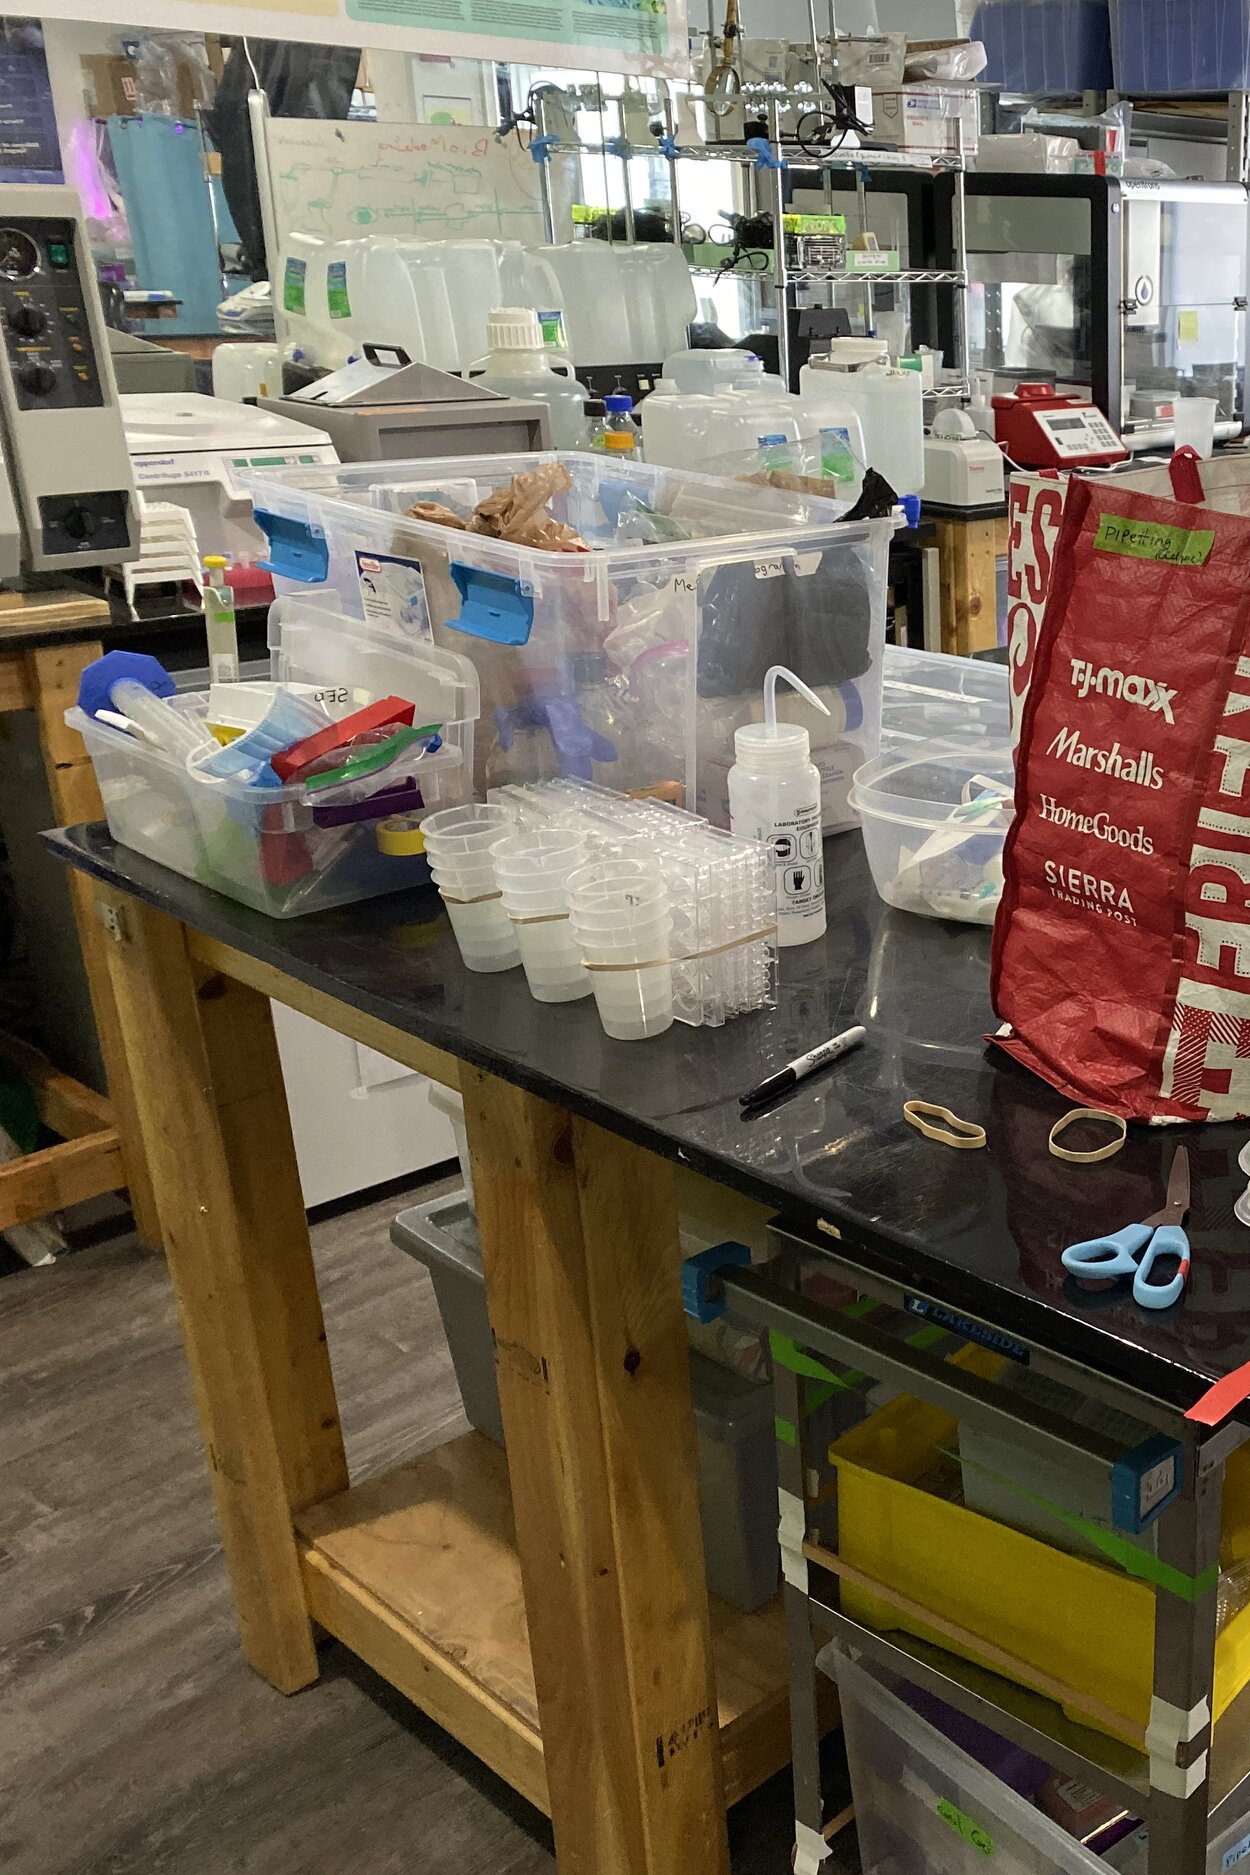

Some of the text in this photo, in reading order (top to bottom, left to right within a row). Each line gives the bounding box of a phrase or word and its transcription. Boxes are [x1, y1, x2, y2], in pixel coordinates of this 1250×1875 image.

[1046, 727, 1164, 790] Marshalls
[774, 817, 811, 828] LABORATORY
[1039, 793, 1154, 855] HomeGoods
[792, 896, 812, 905] TARGET
[1044, 860, 1135, 913] SIERRA
[1050, 886, 1137, 927] TRADING POST
[930, 1307, 1025, 1357] LAKESIDE
